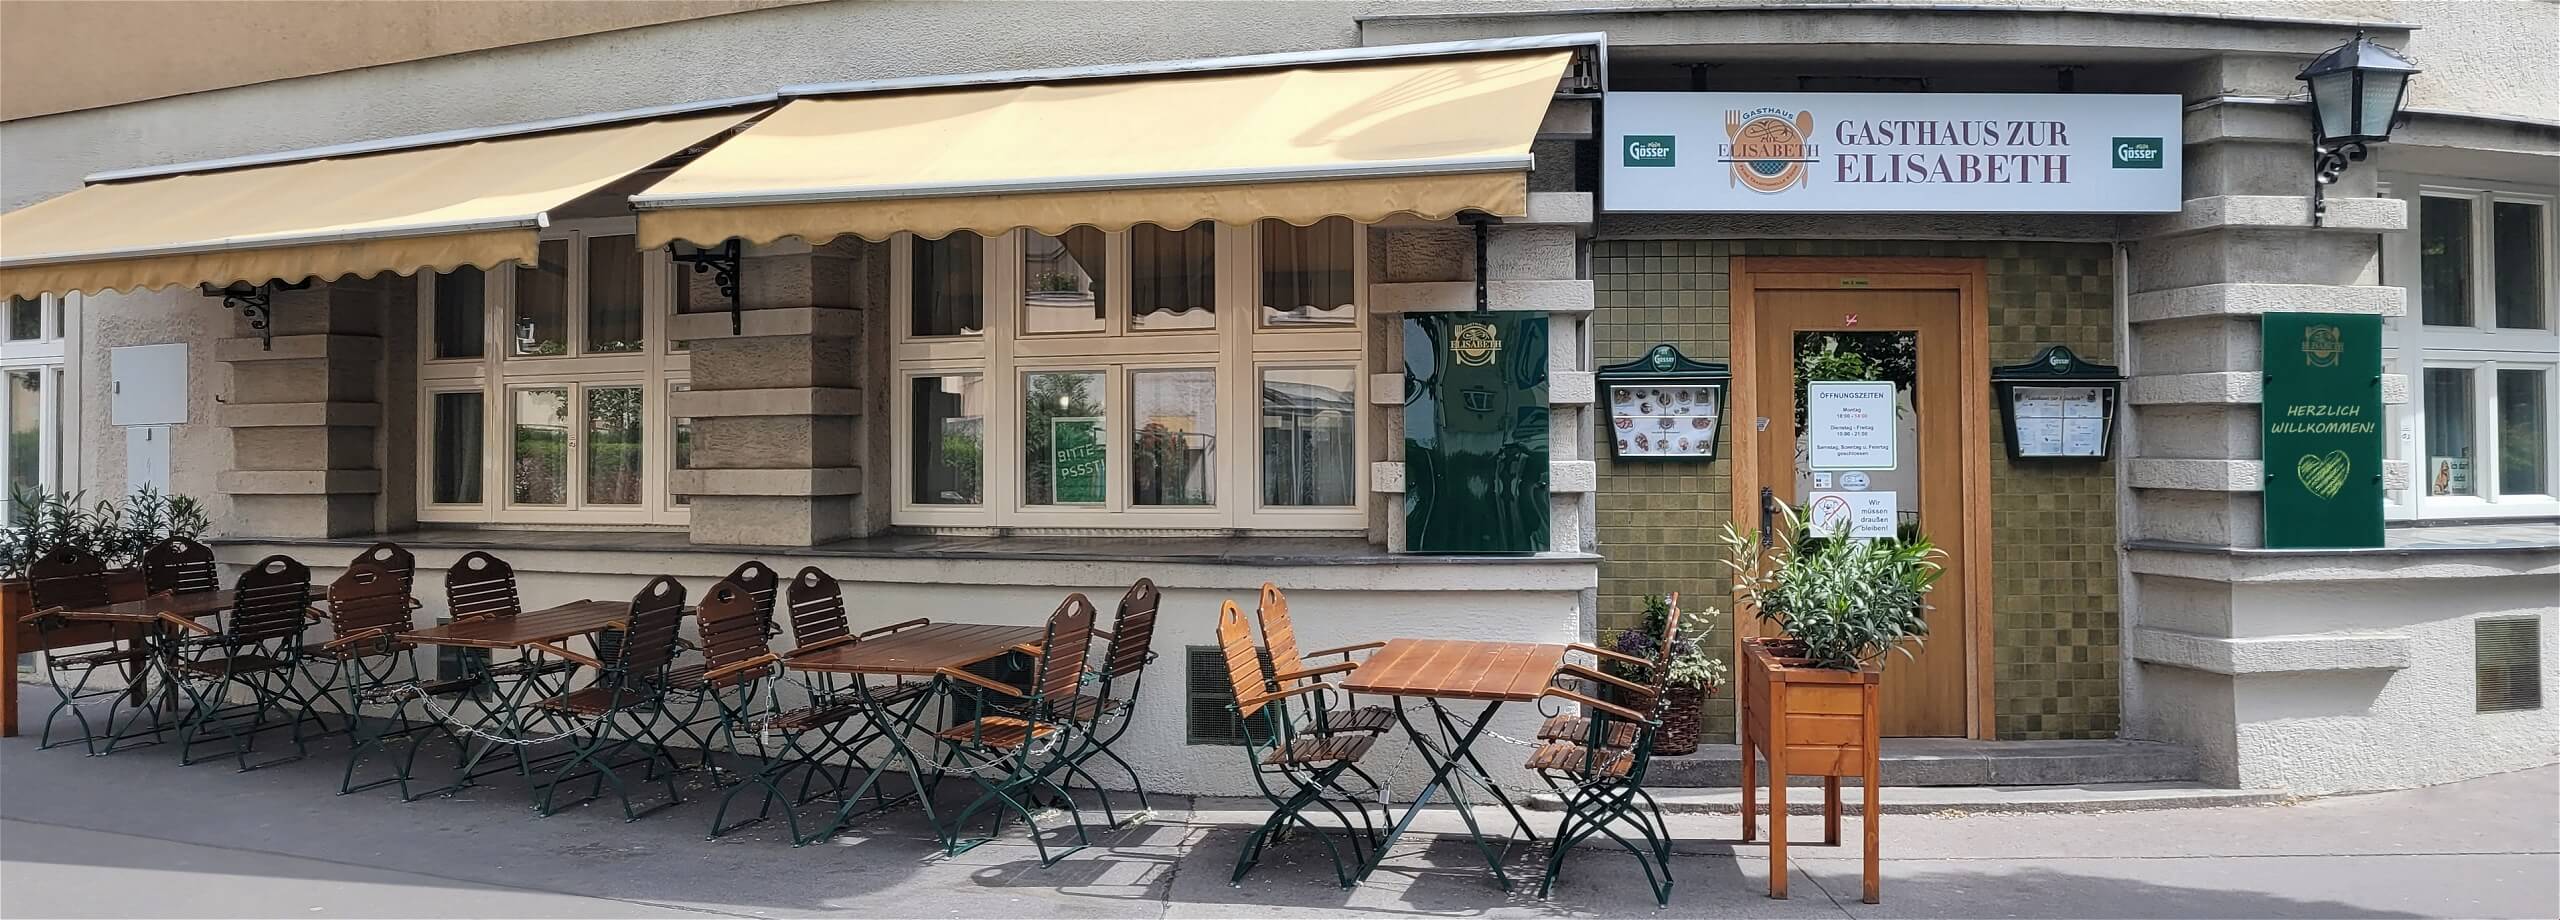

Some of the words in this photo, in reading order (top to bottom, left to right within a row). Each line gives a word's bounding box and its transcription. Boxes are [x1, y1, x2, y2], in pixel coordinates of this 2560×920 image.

[1742, 107, 1794, 119] GASTHAUS
[1835, 119, 2000, 146] GASTHAUS
[2007, 120, 2070, 146] ZUR
[1629, 141, 1670, 160] Gösser
[1718, 143, 1820, 157] ELISABETH
[2118, 143, 2158, 161] Gösser
[1833, 153, 2072, 184] ELISABETH
[1450, 340, 1502, 348] ELISABETH
[1819, 391, 1884, 399] ÖFFNUNGSZEITEN
[2287, 405, 2360, 417] HERZLICH
[2271, 422, 2376, 434] WILLKOMMEN!
[1057, 443, 1095, 463] BITTE
